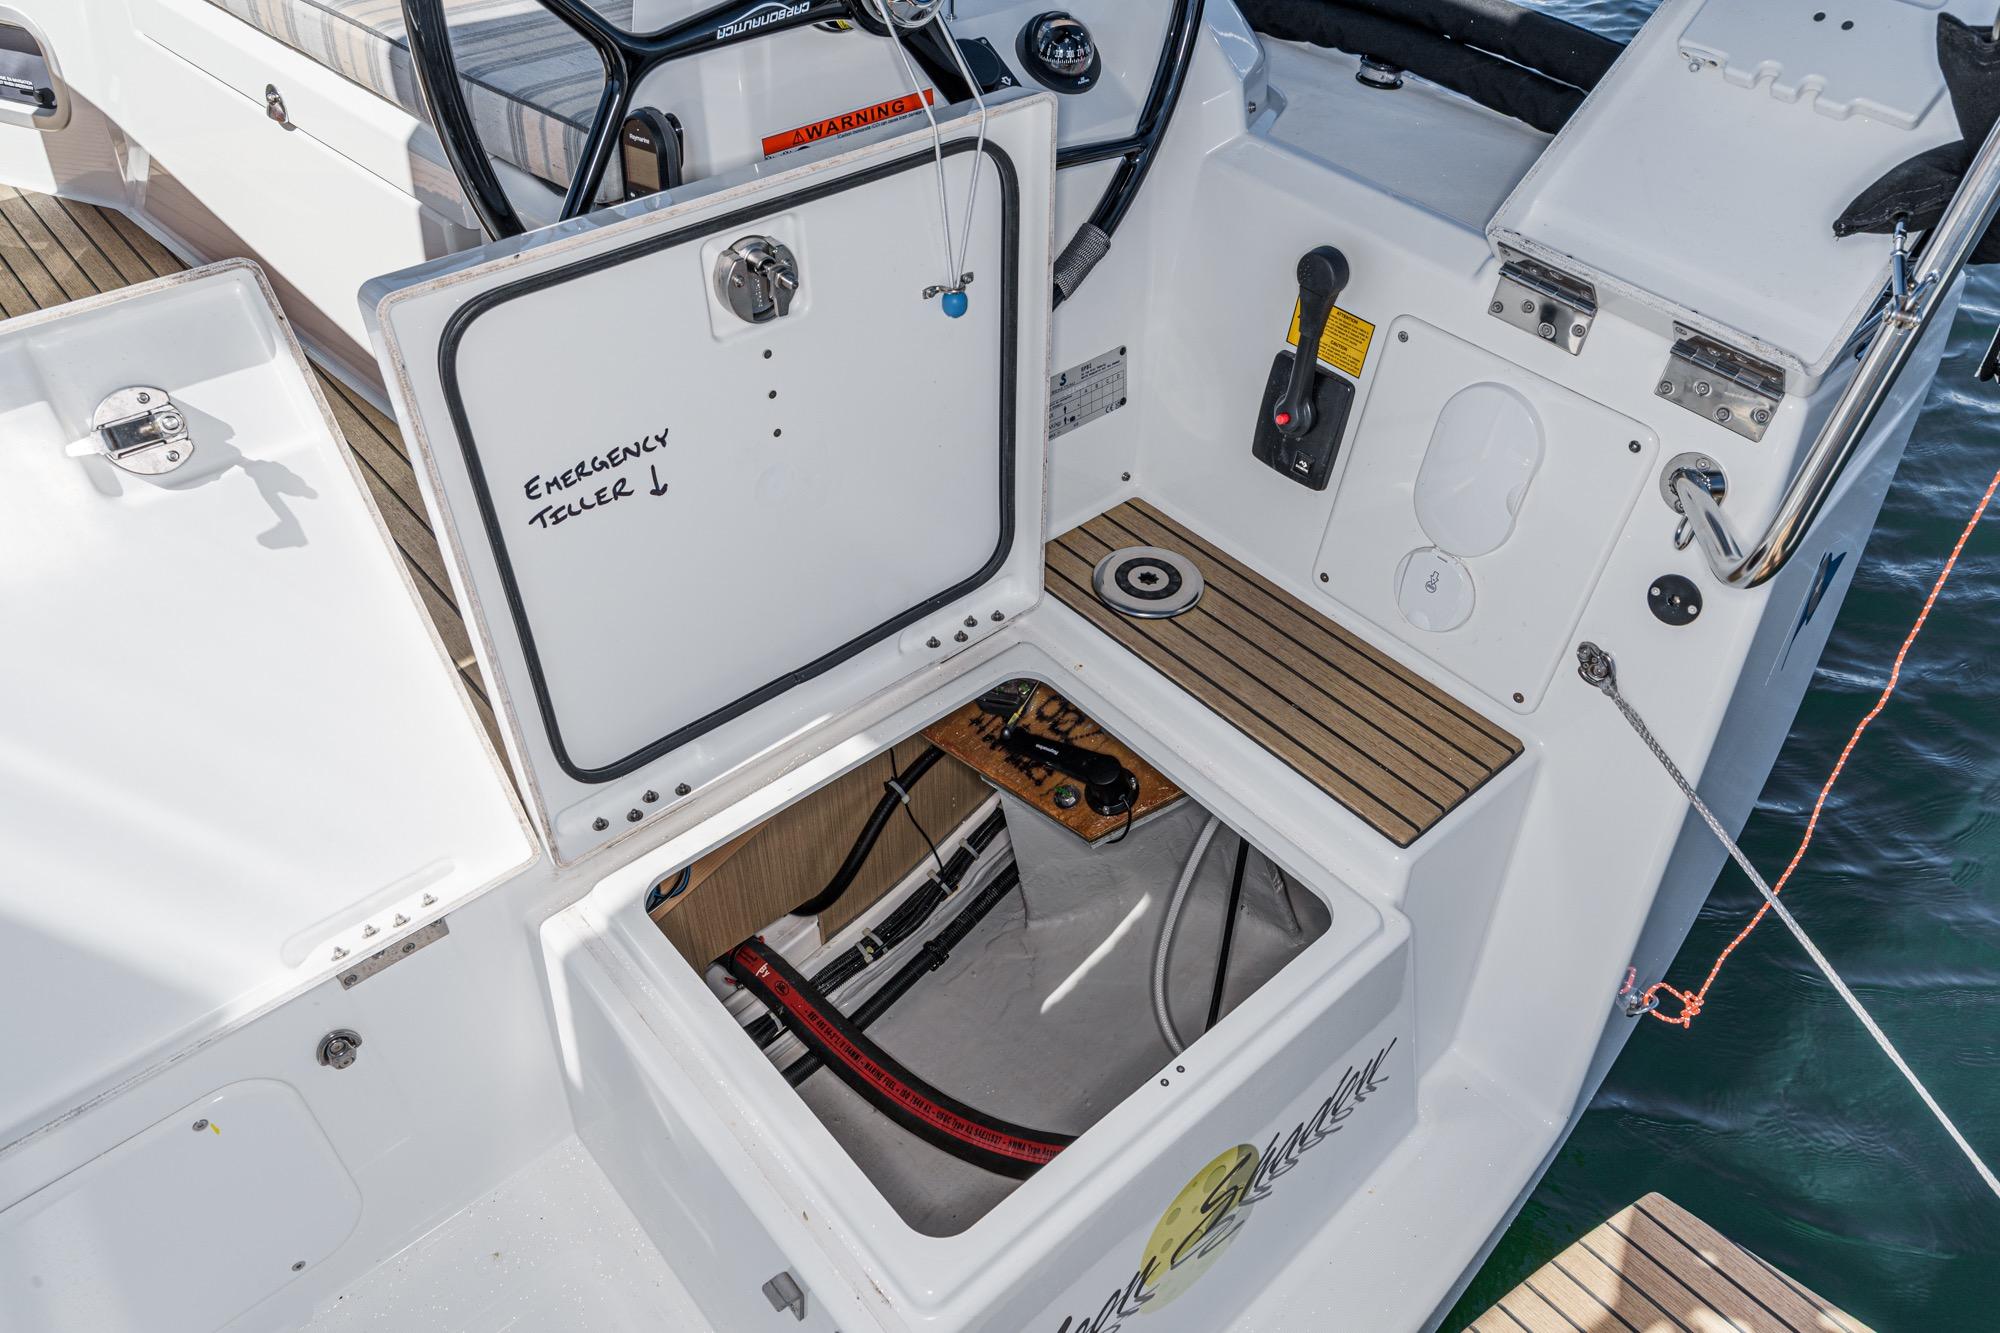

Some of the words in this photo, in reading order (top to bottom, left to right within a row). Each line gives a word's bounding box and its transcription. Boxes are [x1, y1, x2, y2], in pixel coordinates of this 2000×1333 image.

[716, 2, 811, 40] CARBONAUTICA
[805, 100, 905, 140] WARNING
[524, 427, 669, 500] EMERGENCY
[528, 477, 635, 529] TILLER
[863, 1063, 885, 1080] MARINE
[883, 1077, 896, 1090] FUEL
